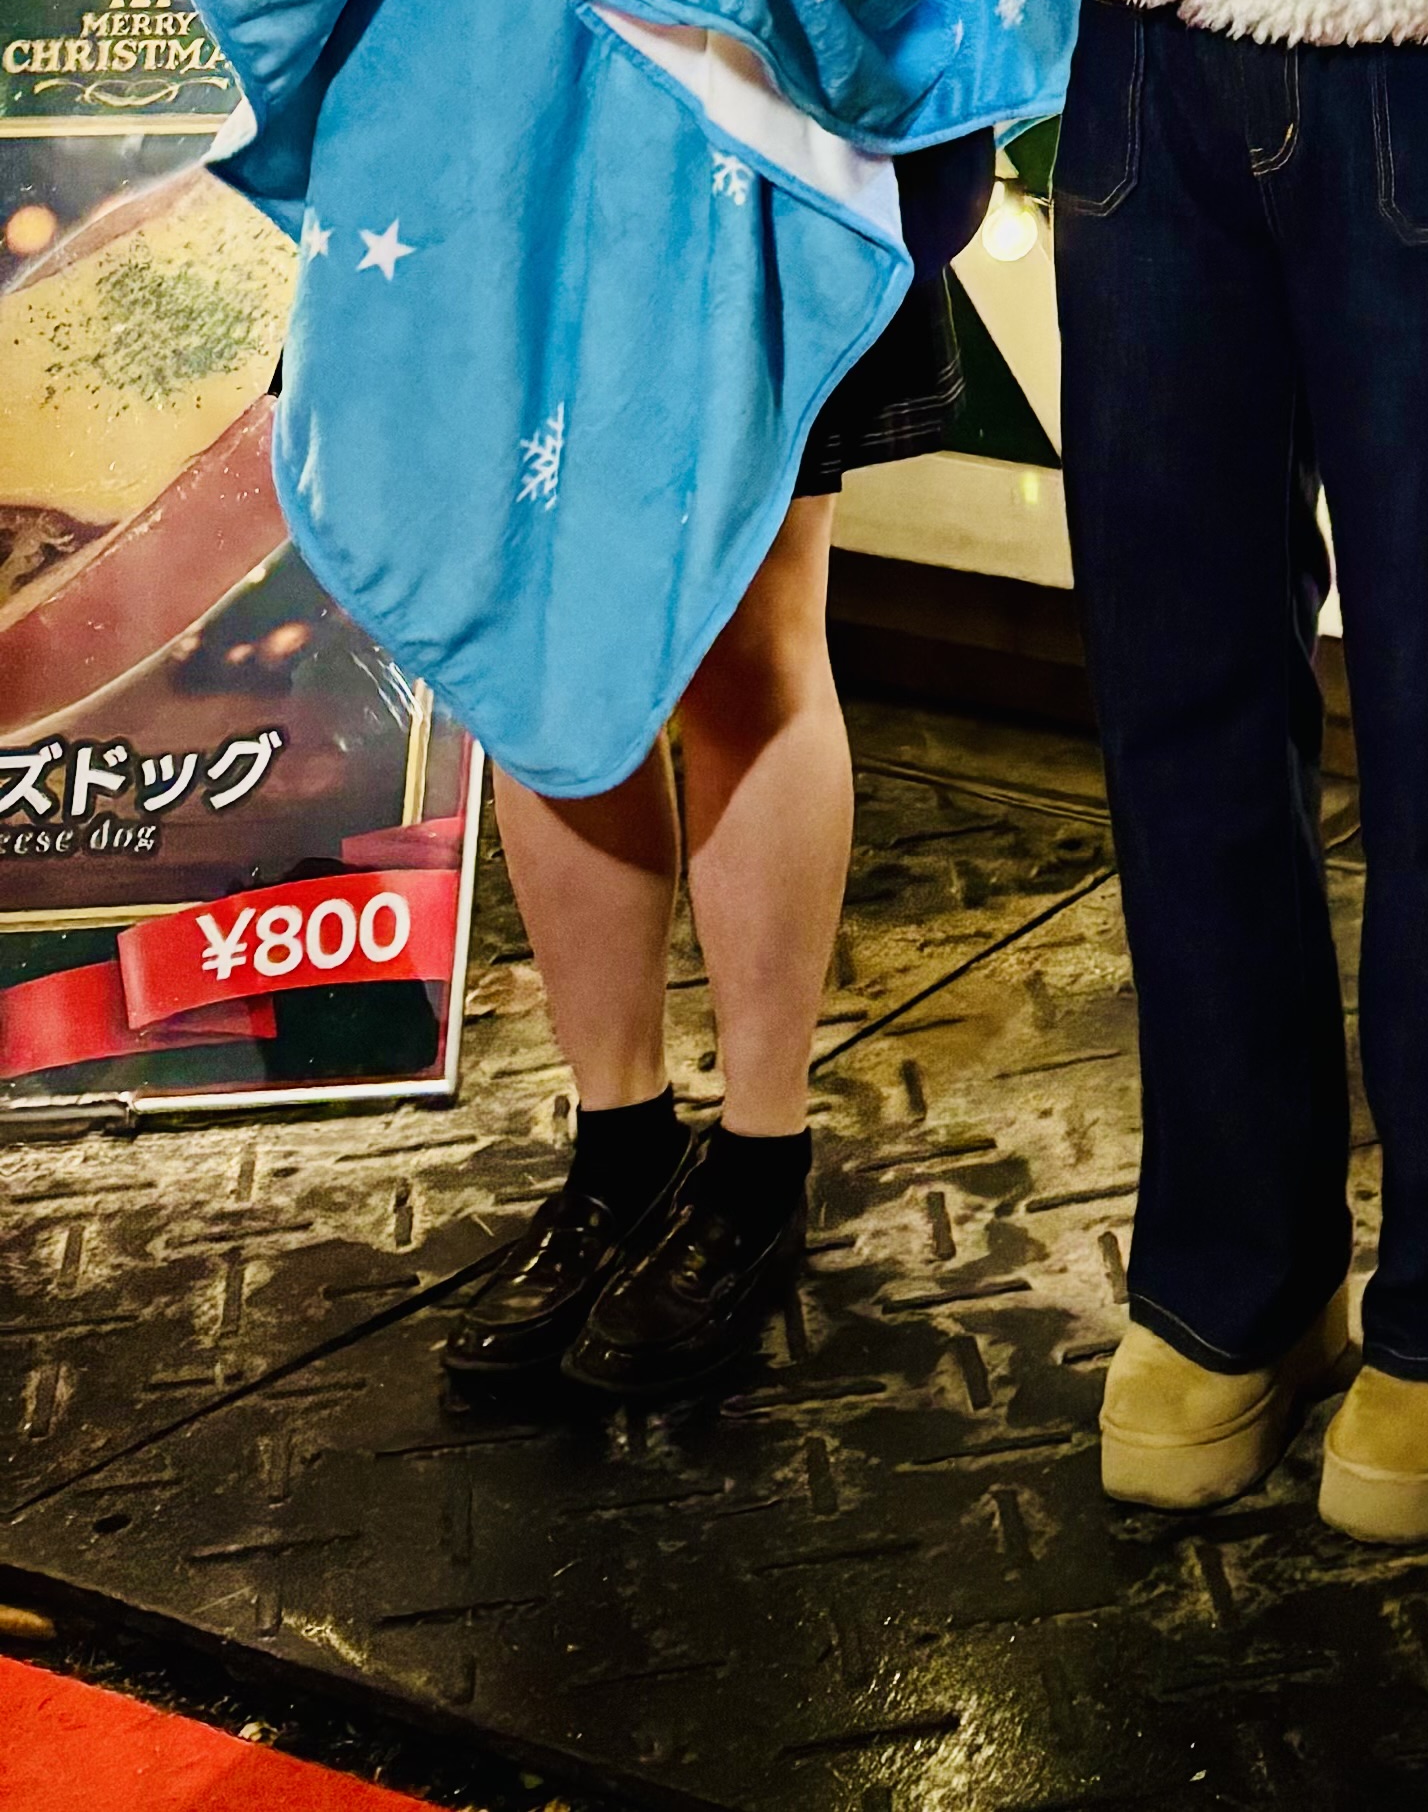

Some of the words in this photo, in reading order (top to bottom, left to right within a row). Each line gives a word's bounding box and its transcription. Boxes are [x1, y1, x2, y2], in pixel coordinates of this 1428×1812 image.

[80, 10, 200, 39] MERRY
[0, 729, 284, 817] ズドッグ
[89, 819, 157, 853] dog
[196, 890, 412, 982] ¥800
